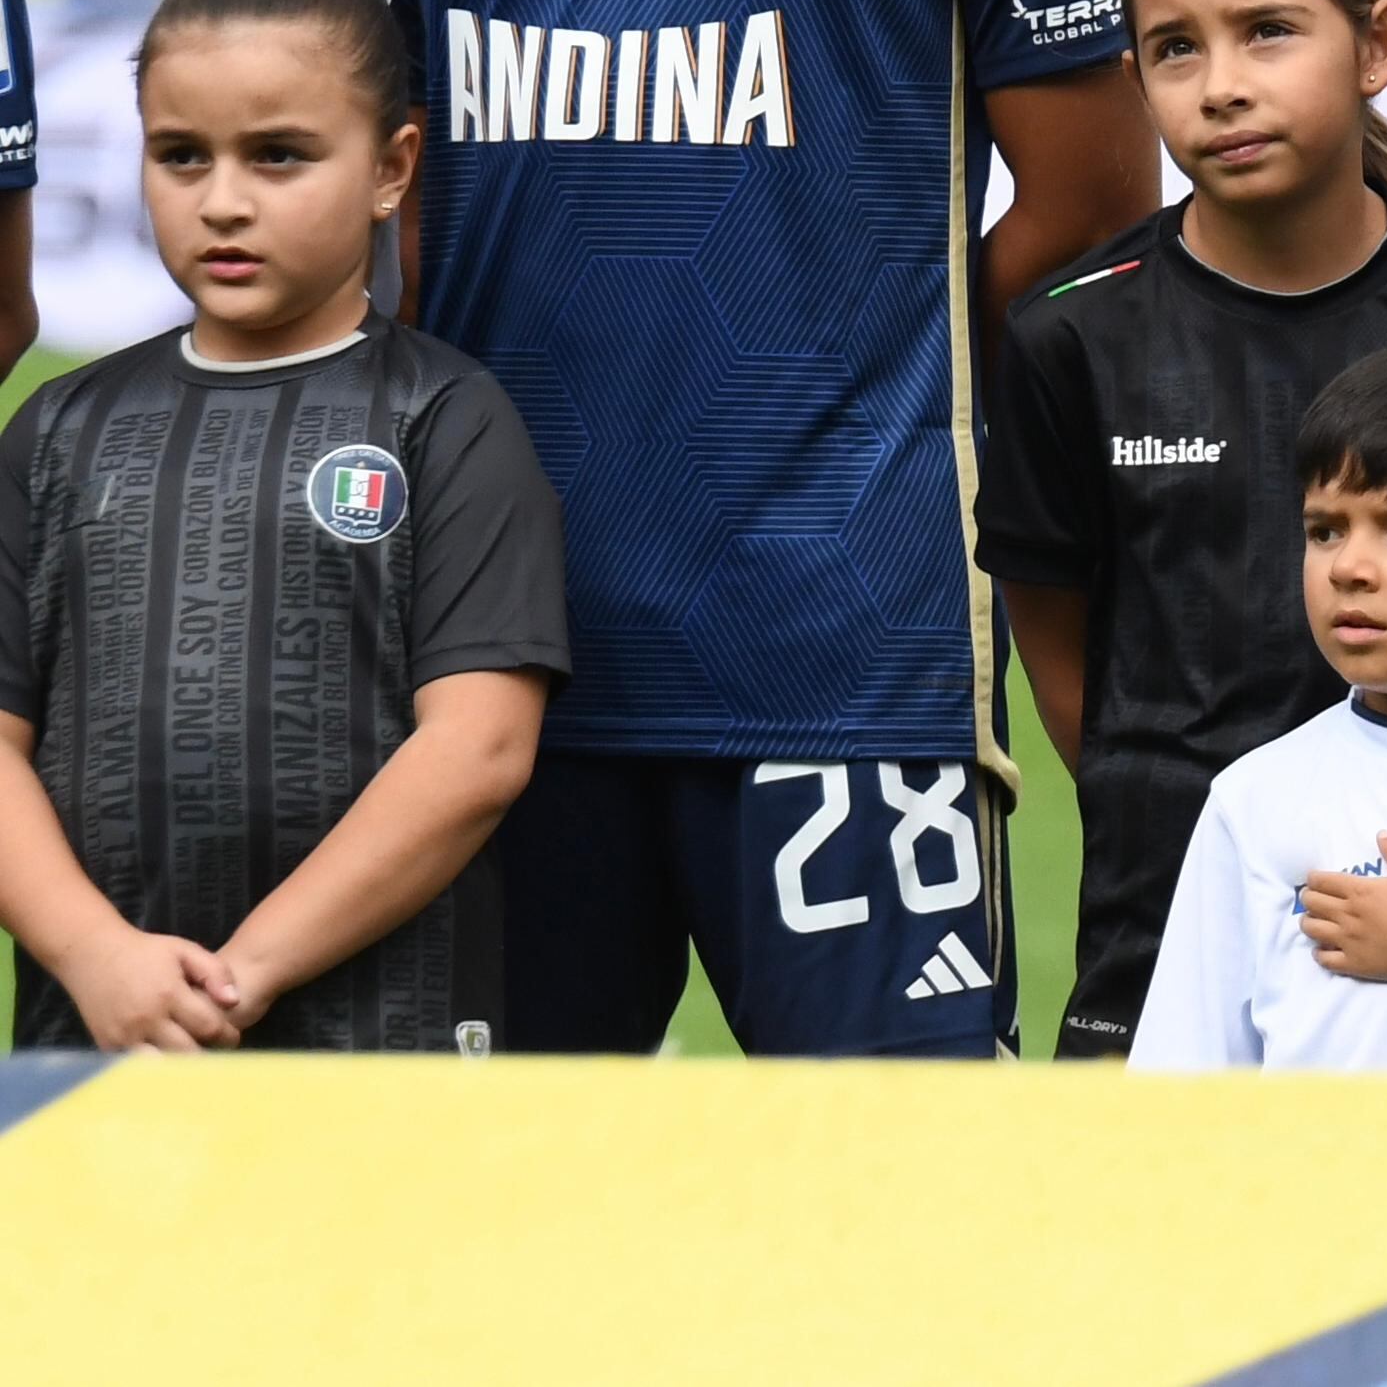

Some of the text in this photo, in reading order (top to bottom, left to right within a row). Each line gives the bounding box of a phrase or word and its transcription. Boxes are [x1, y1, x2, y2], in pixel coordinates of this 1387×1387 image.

[1032, 25, 1104, 45] GLOBAL
[447, 7, 795, 147] ANDINA
[123, 411, 172, 487] BLANCO
[190, 409, 232, 479] BLANCO
[248, 408, 270, 430] SOY
[326, 405, 353, 442] ONCE
[1111, 435, 1222, 466] Hillside
[235, 464, 256, 492] DEL
[216, 495, 252, 591] CALDAS
[281, 501, 311, 610] HISTORIA
[315, 528, 352, 611] FIDE
[121, 613, 143, 714] CAMPEONES
[177, 595, 219, 656] SOY
[217, 596, 246, 726] CONTINENTAL
[322, 620, 349, 702] BLANCO
[172, 666, 215, 754] ONCE
[275, 616, 321, 830] MANIZALES
[322, 707, 349, 789] BLANCO
[100, 719, 134, 822] ALMA
[173, 762, 214, 826] DEL
[752, 761, 981, 934] 28
